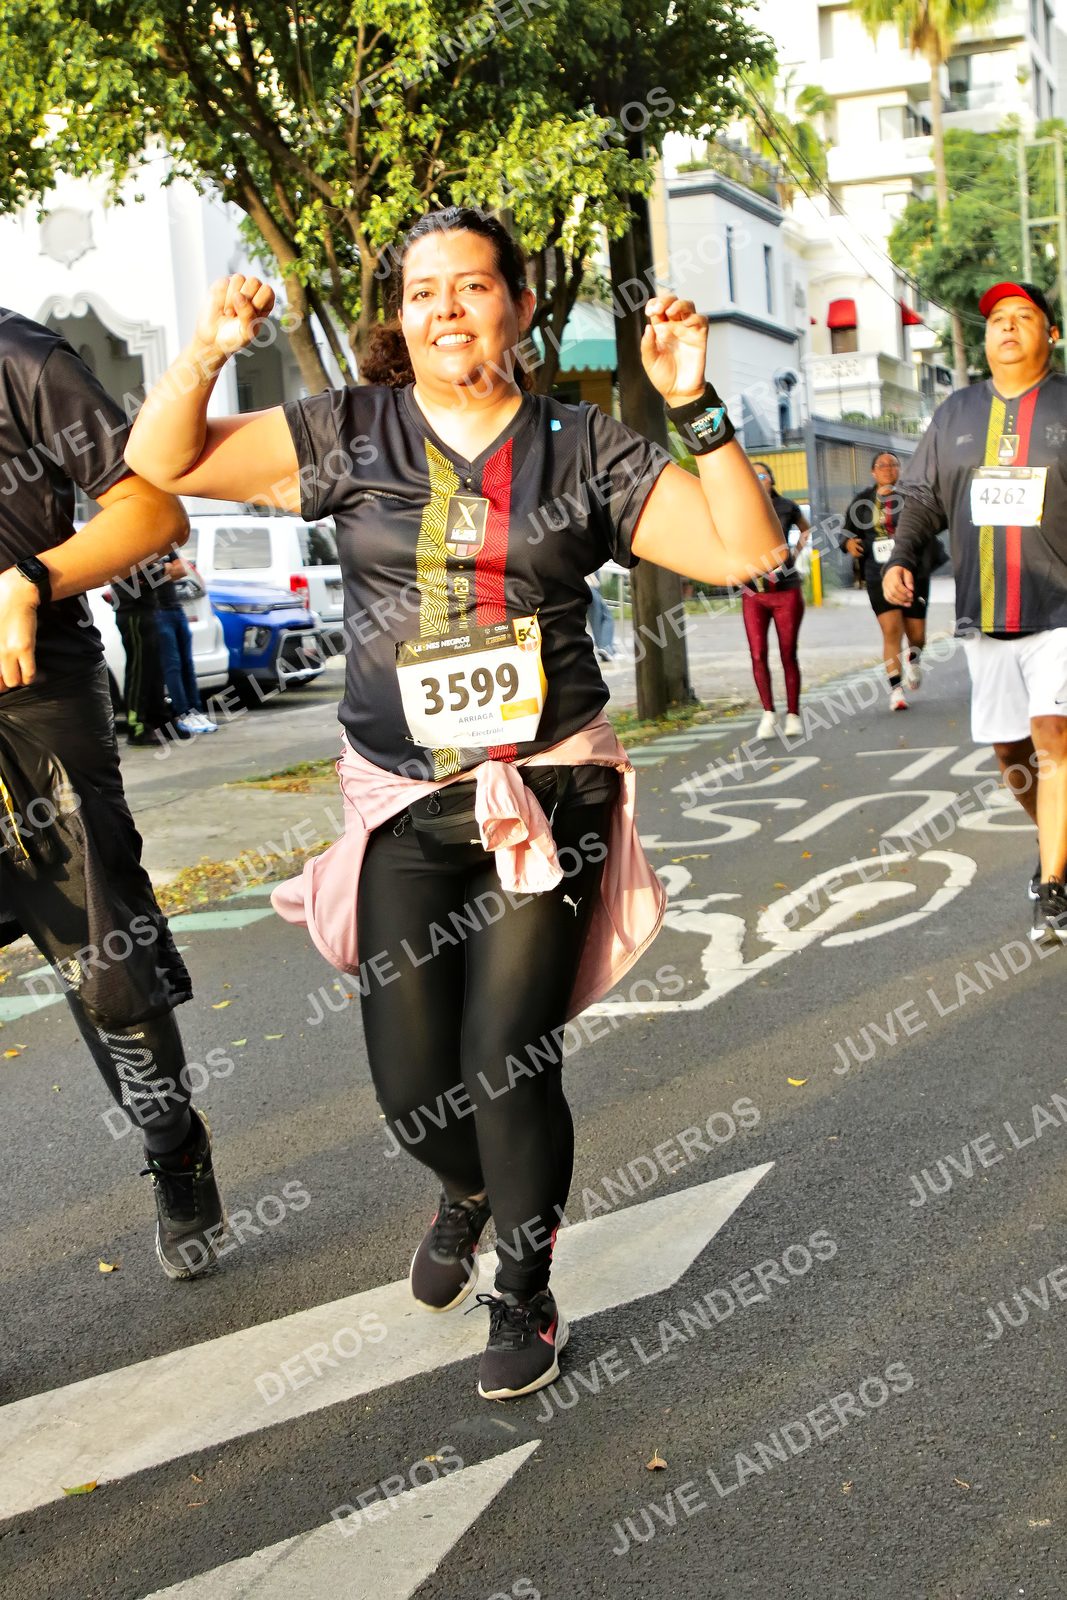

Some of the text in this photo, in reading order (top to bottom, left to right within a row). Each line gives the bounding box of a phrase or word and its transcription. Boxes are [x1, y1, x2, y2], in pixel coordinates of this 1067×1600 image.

[980, 487, 1026, 505] 4262
[420, 662, 519, 716] 3599
[458, 712, 494, 724] ARRIAGA
